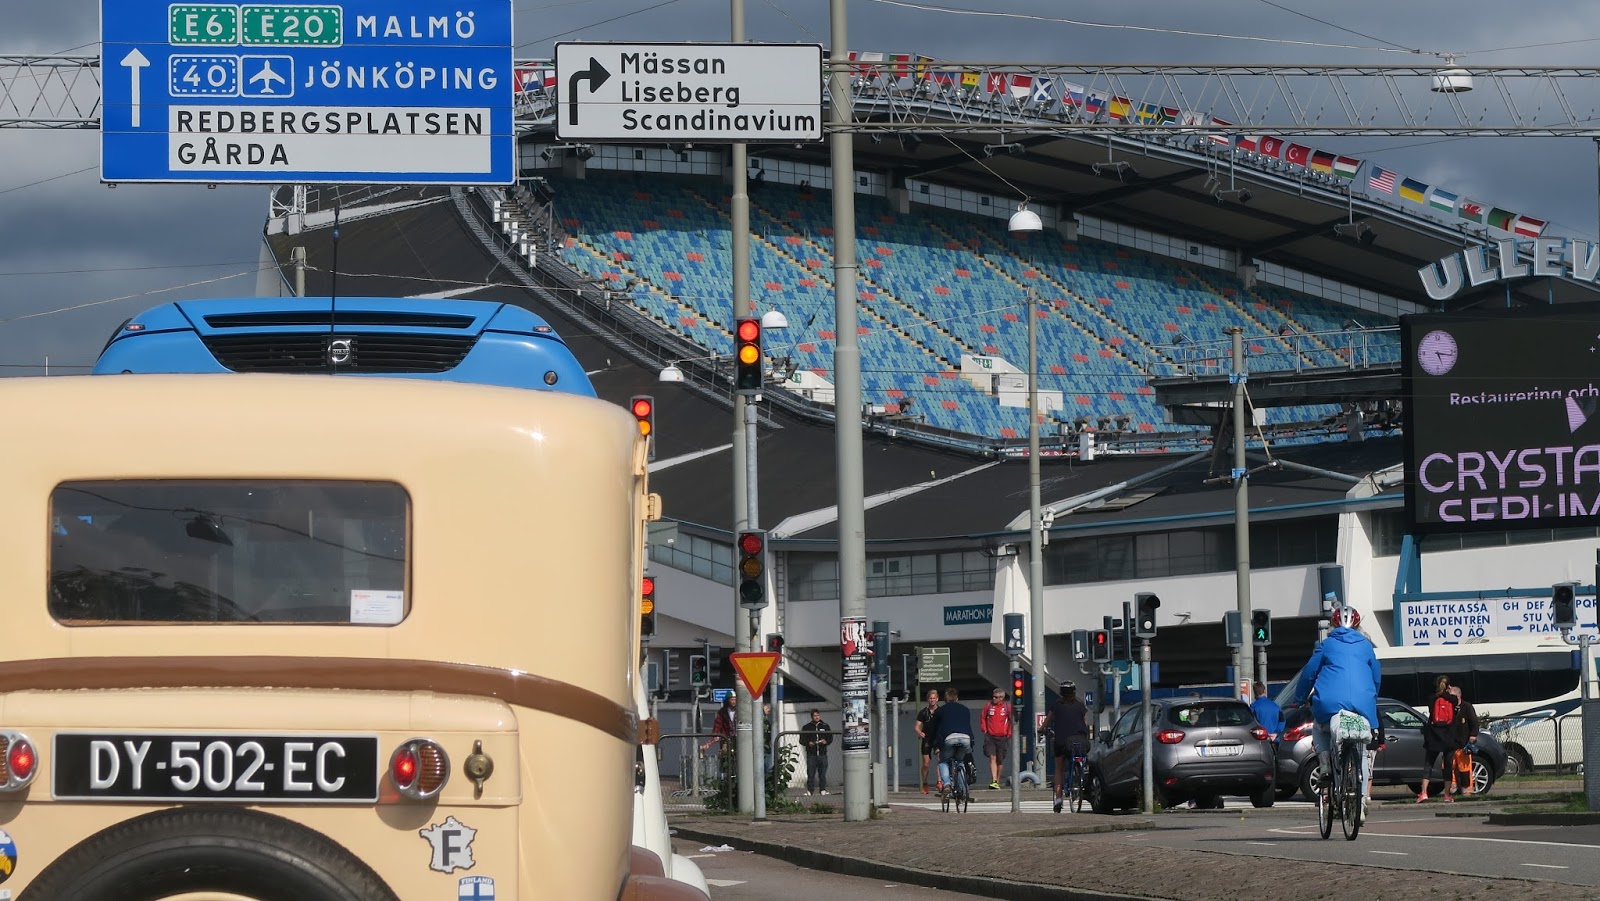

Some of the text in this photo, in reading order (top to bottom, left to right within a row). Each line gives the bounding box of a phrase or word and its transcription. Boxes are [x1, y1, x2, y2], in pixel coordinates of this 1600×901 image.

[185, 11, 475, 39] E6 E20 MALMÖ
[182, 60, 499, 90] 40 JÖNKÖPING
[620, 52, 726, 75] Mässan
[621, 80, 741, 108] Liseberg
[177, 110, 483, 135] REDBERGSPLATSEN
[622, 109, 815, 132] Scandinavium
[177, 136, 290, 166] GÅRDA
[1419, 444, 1600, 494] CRYSTA
[946, 609, 985, 621] MARATHON
[1407, 603, 1488, 615] BILJETTKASSA
[1503, 602, 1519, 611] GH
[1527, 601, 1545, 610] DEF
[1523, 613, 1542, 622] STU
[1408, 613, 1491, 627] PARADENTRÉN
[1413, 629, 1429, 639] LM
[1438, 628, 1447, 638] N
[1453, 627, 1463, 638] O
[89, 740, 346, 794] DY-502-EC
[442, 829, 462, 867] F
[460, 876, 493, 885] FINLAND
